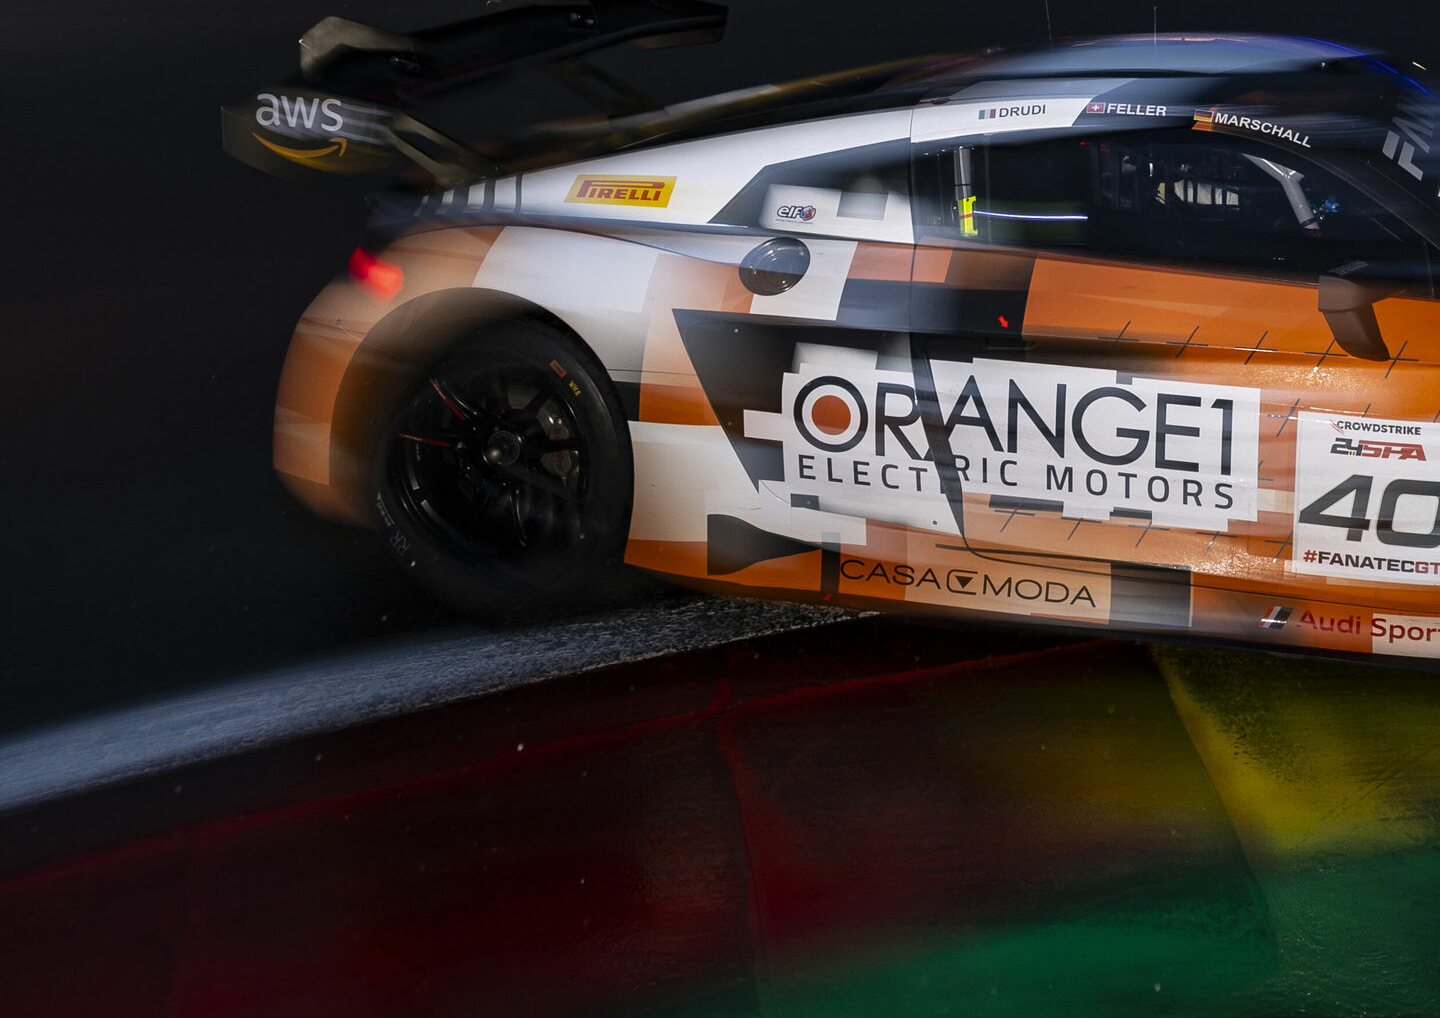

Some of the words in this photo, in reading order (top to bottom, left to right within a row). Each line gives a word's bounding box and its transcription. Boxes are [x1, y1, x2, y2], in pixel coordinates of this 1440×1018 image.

[256, 93, 343, 131] aws
[999, 104, 1047, 118] DRUDI
[1107, 102, 1167, 117] FELLER
[1214, 112, 1312, 148] MARSCHALL
[576, 179, 666, 202] PIRELLI
[793, 374, 1235, 476] ORANGE1
[1336, 420, 1422, 436] CROWDSTRIKE
[799, 454, 1019, 493] ELECTRIC
[1046, 464, 1235, 510] MOTORS
[840, 559, 942, 590] CASA
[982, 573, 1097, 608] MODA
[1297, 610, 1362, 635] Audi
